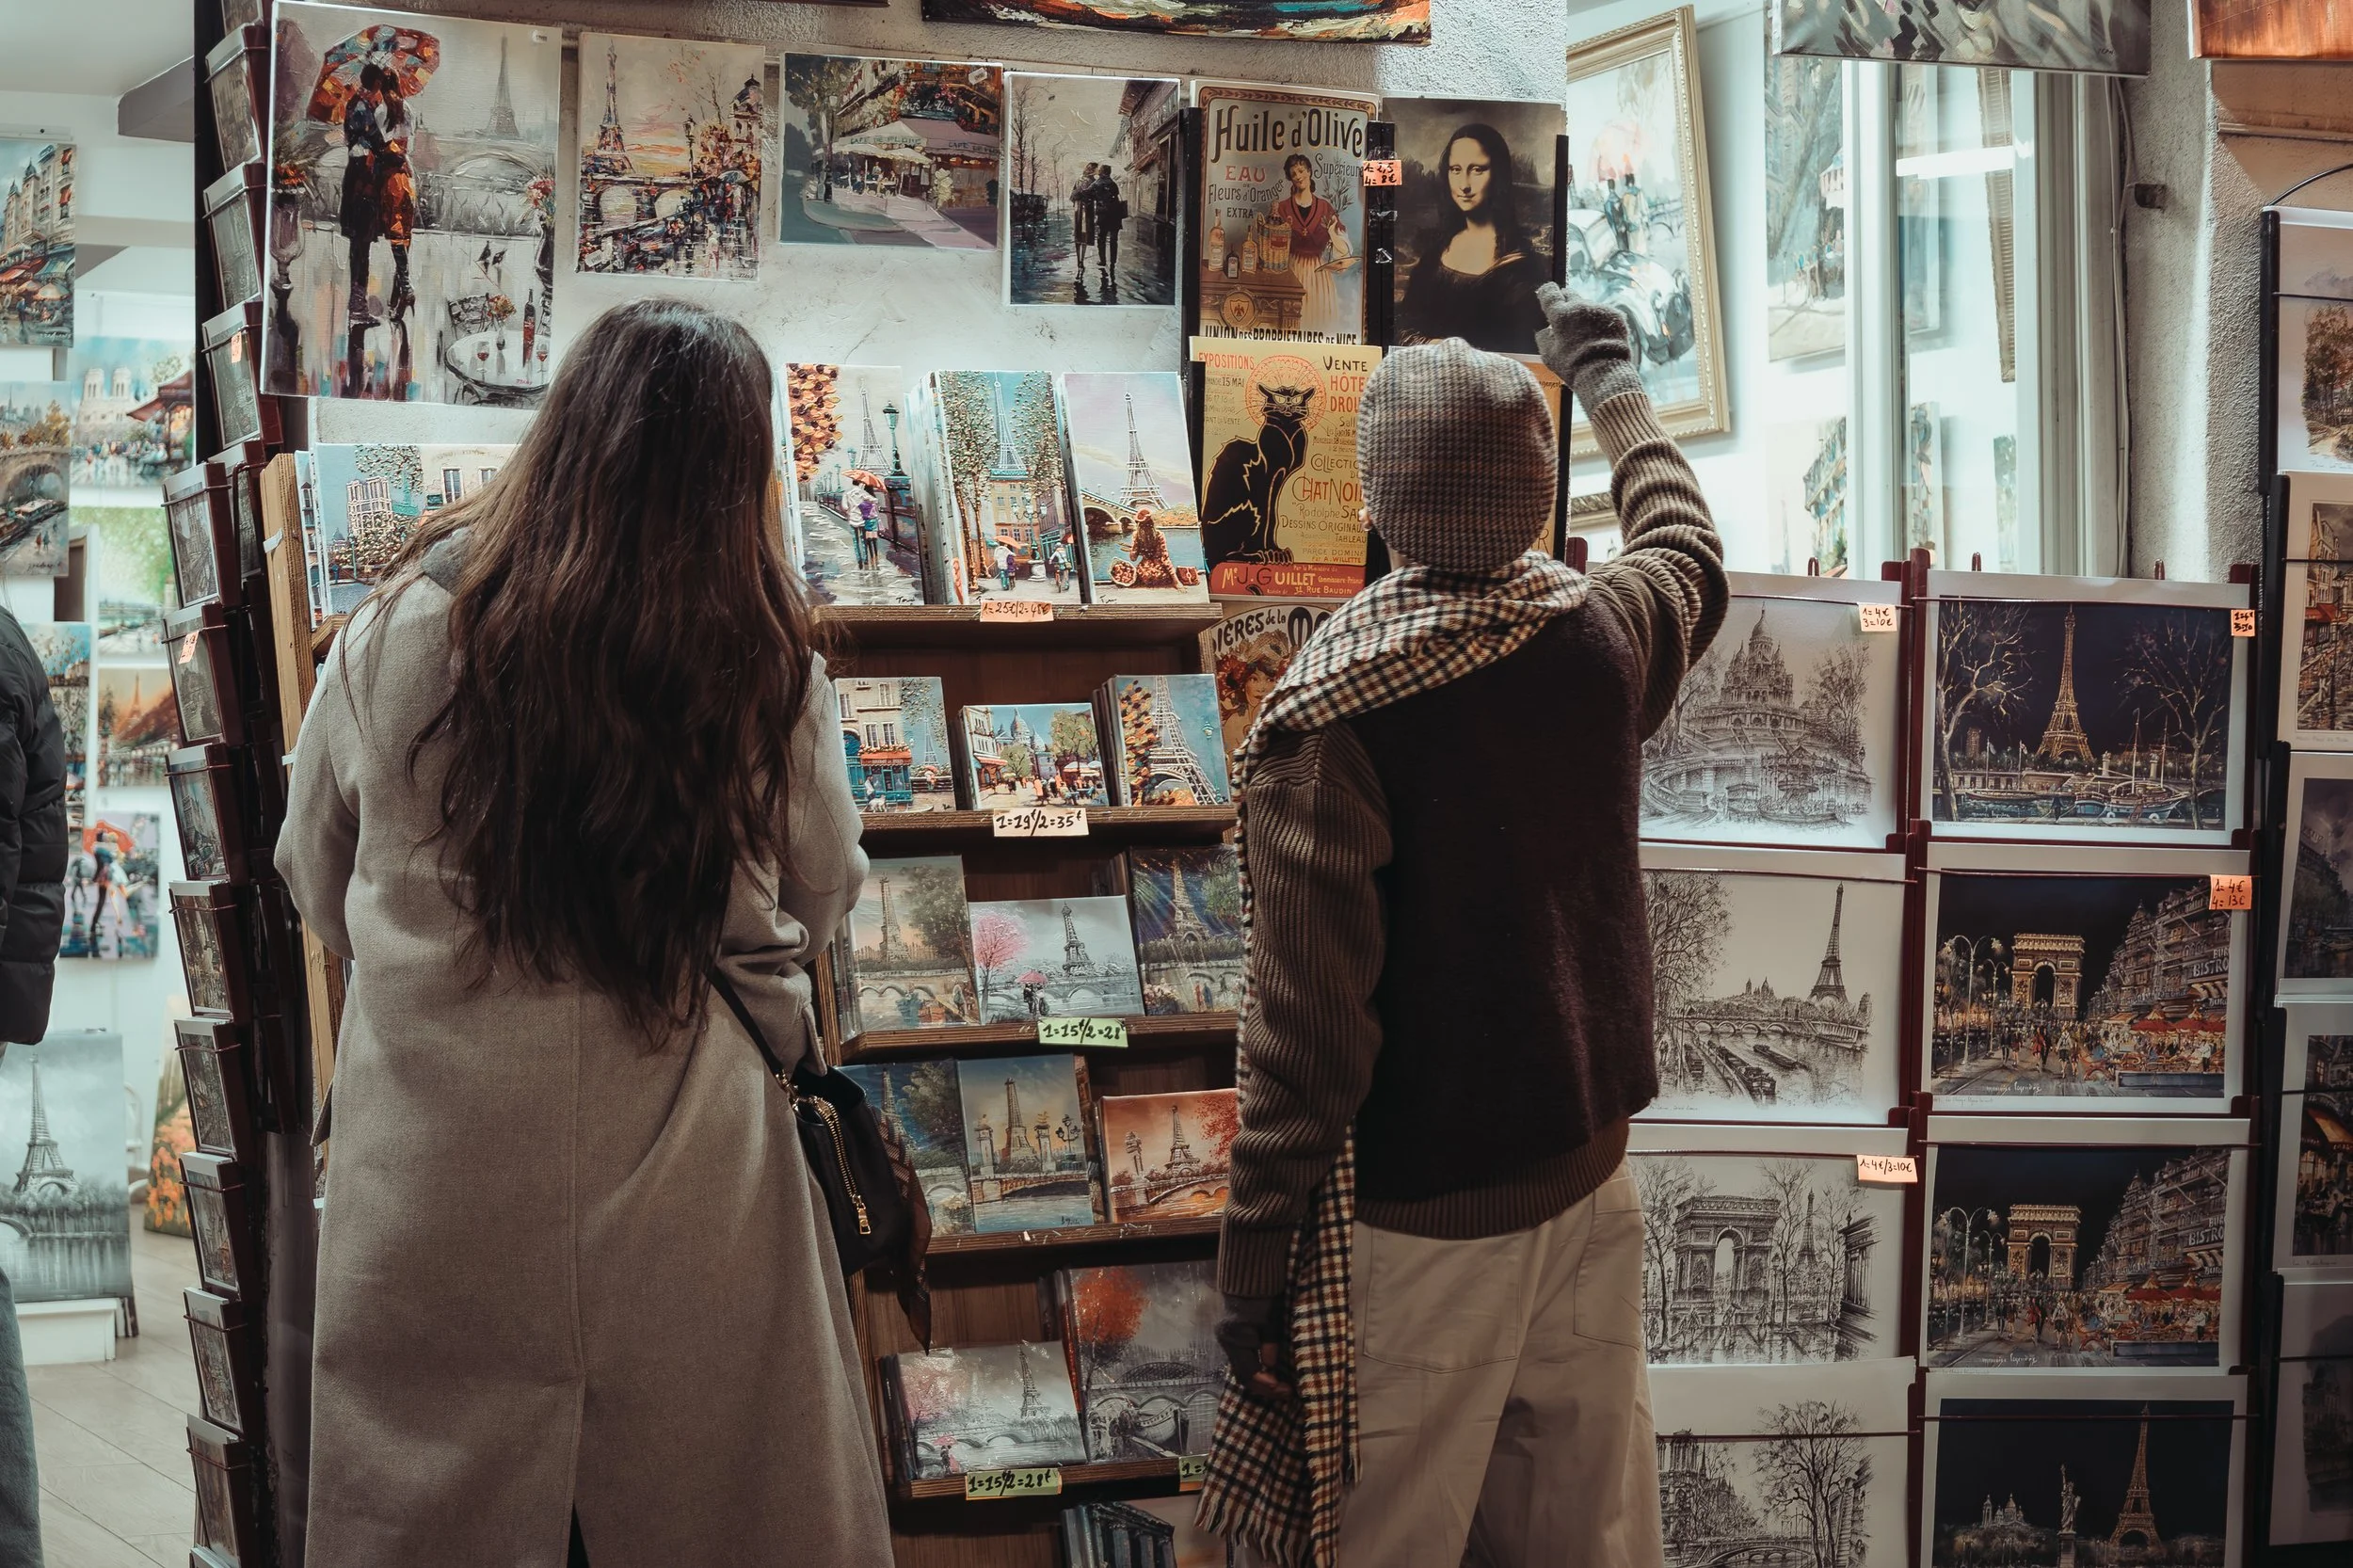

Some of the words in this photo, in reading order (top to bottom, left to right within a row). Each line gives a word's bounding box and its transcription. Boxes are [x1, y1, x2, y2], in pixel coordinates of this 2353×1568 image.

[1210, 104, 1285, 164] Huile
[1291, 108, 1363, 158] d'Olive
[1225, 165, 1266, 184] EAU
[1209, 184, 1241, 204] Fleurs
[1243, 179, 1284, 203] d'Oranger
[1226, 207, 1254, 218] EXTRA
[1322, 355, 1368, 372] VENTE
[1232, 377, 1245, 388] MAI
[1330, 372, 1365, 392] HÔTE
[1330, 396, 1361, 413] DROU
[1339, 416, 1355, 427] Sall
[1311, 454, 1359, 472] COLLECTI
[1292, 472, 1329, 504] CHAT
[1341, 505, 1361, 522] SAL
[1280, 515, 1316, 530] DESSINS
[1336, 533, 1367, 544] TABLEAU
[1332, 549, 1365, 557] DOMINE
[1257, 567, 1316, 586] GUILLET
[1323, 586, 1353, 595] BAUDIN
[1213, 611, 1265, 653] IÈRES
[1266, 609, 1276, 625] de
[1276, 609, 1286, 624] la
